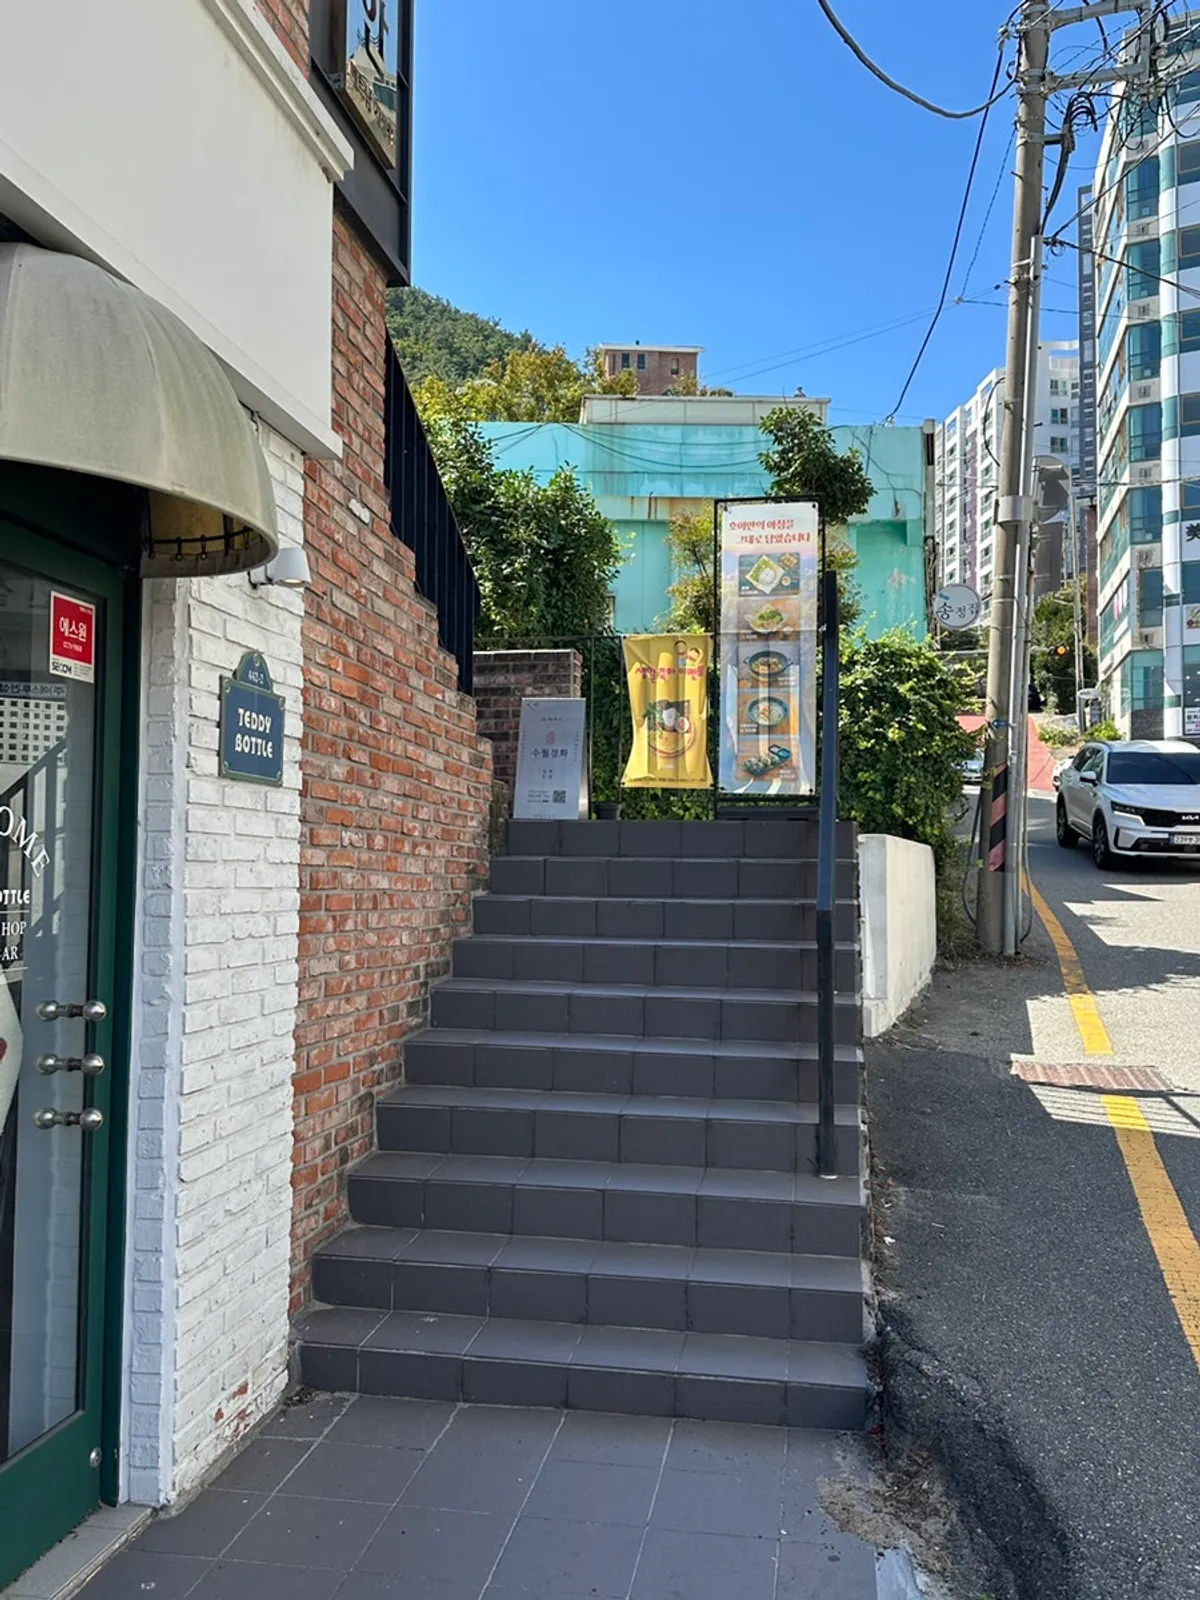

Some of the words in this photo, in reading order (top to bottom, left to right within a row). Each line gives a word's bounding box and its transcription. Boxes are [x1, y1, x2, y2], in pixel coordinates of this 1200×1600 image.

[765, 532, 811, 544] 담았습니다
[59, 616, 87, 642] 에스원
[237, 707, 272, 734] TEDDY
[234, 733, 273, 758] BOTTLE
